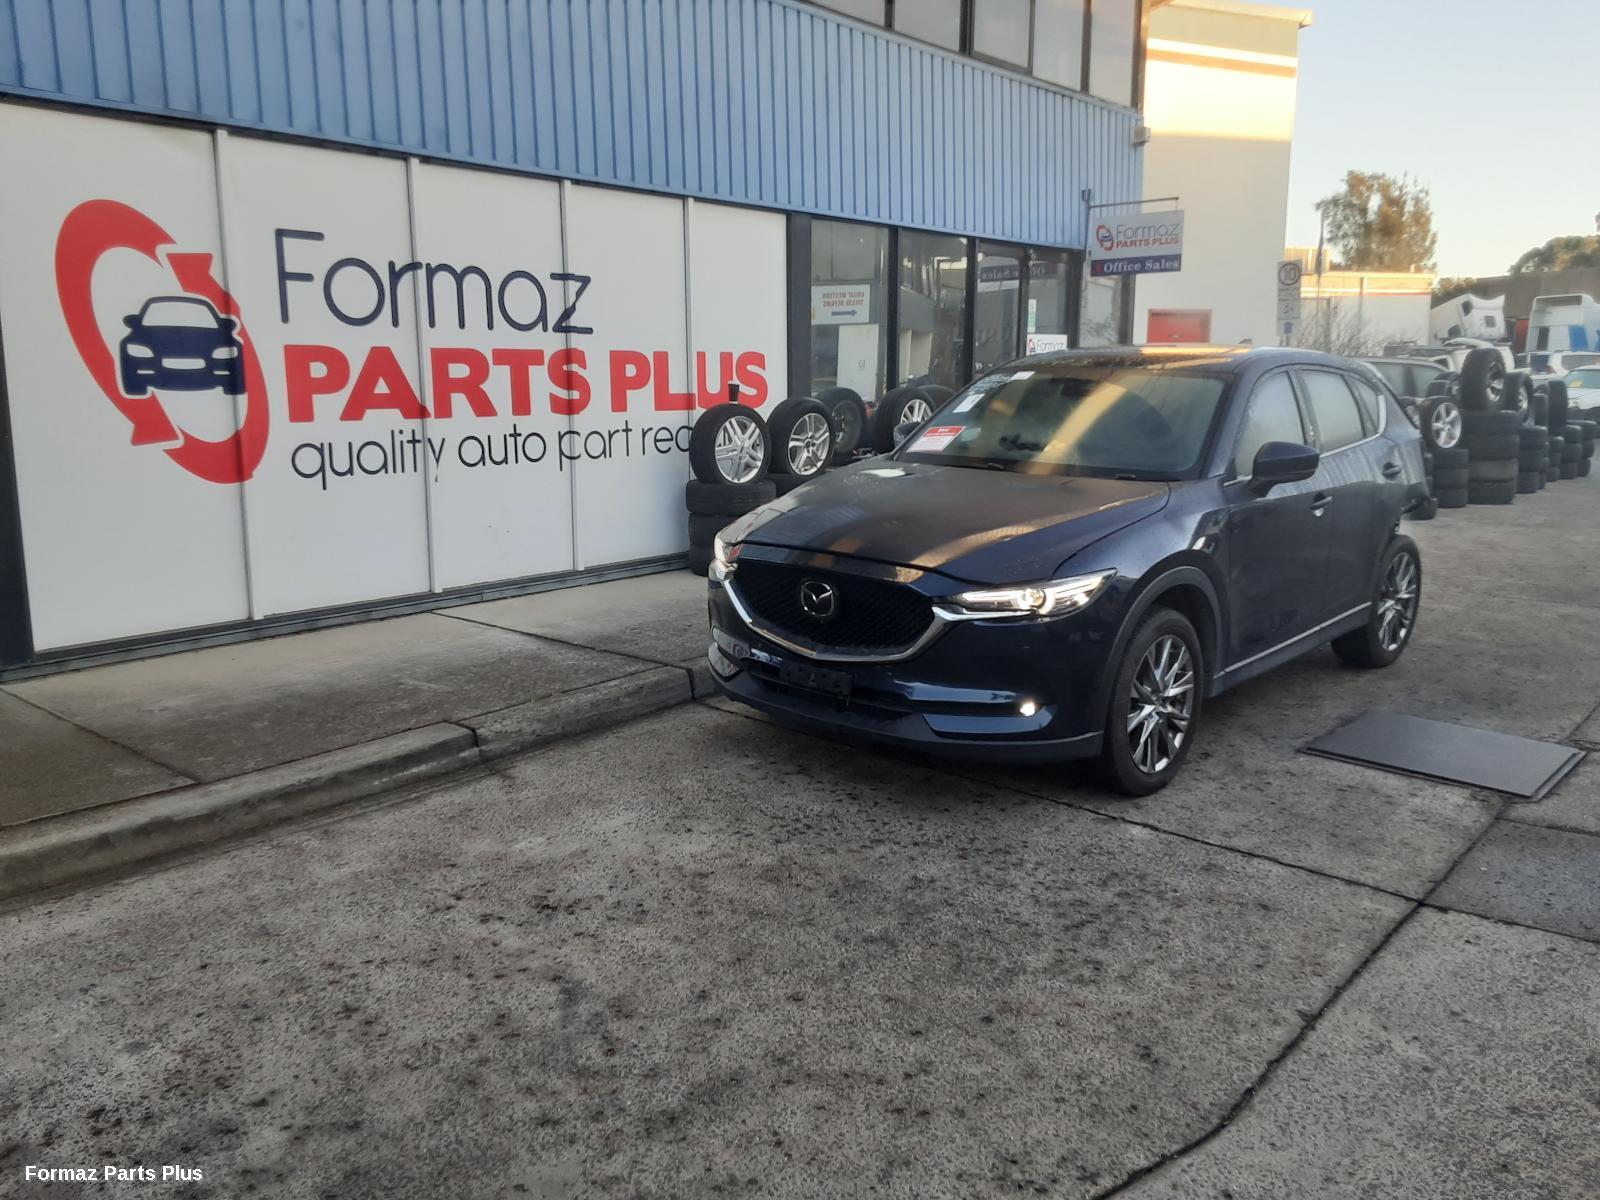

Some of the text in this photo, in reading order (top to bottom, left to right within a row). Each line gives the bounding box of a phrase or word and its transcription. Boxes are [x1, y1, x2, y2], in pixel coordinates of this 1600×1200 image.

[1116, 223, 1180, 240] Formaz
[1116, 237, 1179, 248] PARTS PLUS
[1103, 258, 1178, 273] Office Sales
[1284, 267, 1297, 281] 10
[275, 228, 593, 334] Formaz
[283, 344, 768, 423] PARTS PLUS
[291, 429, 445, 490] quality
[458, 424, 547, 467] auto
[558, 419, 633, 472] part
